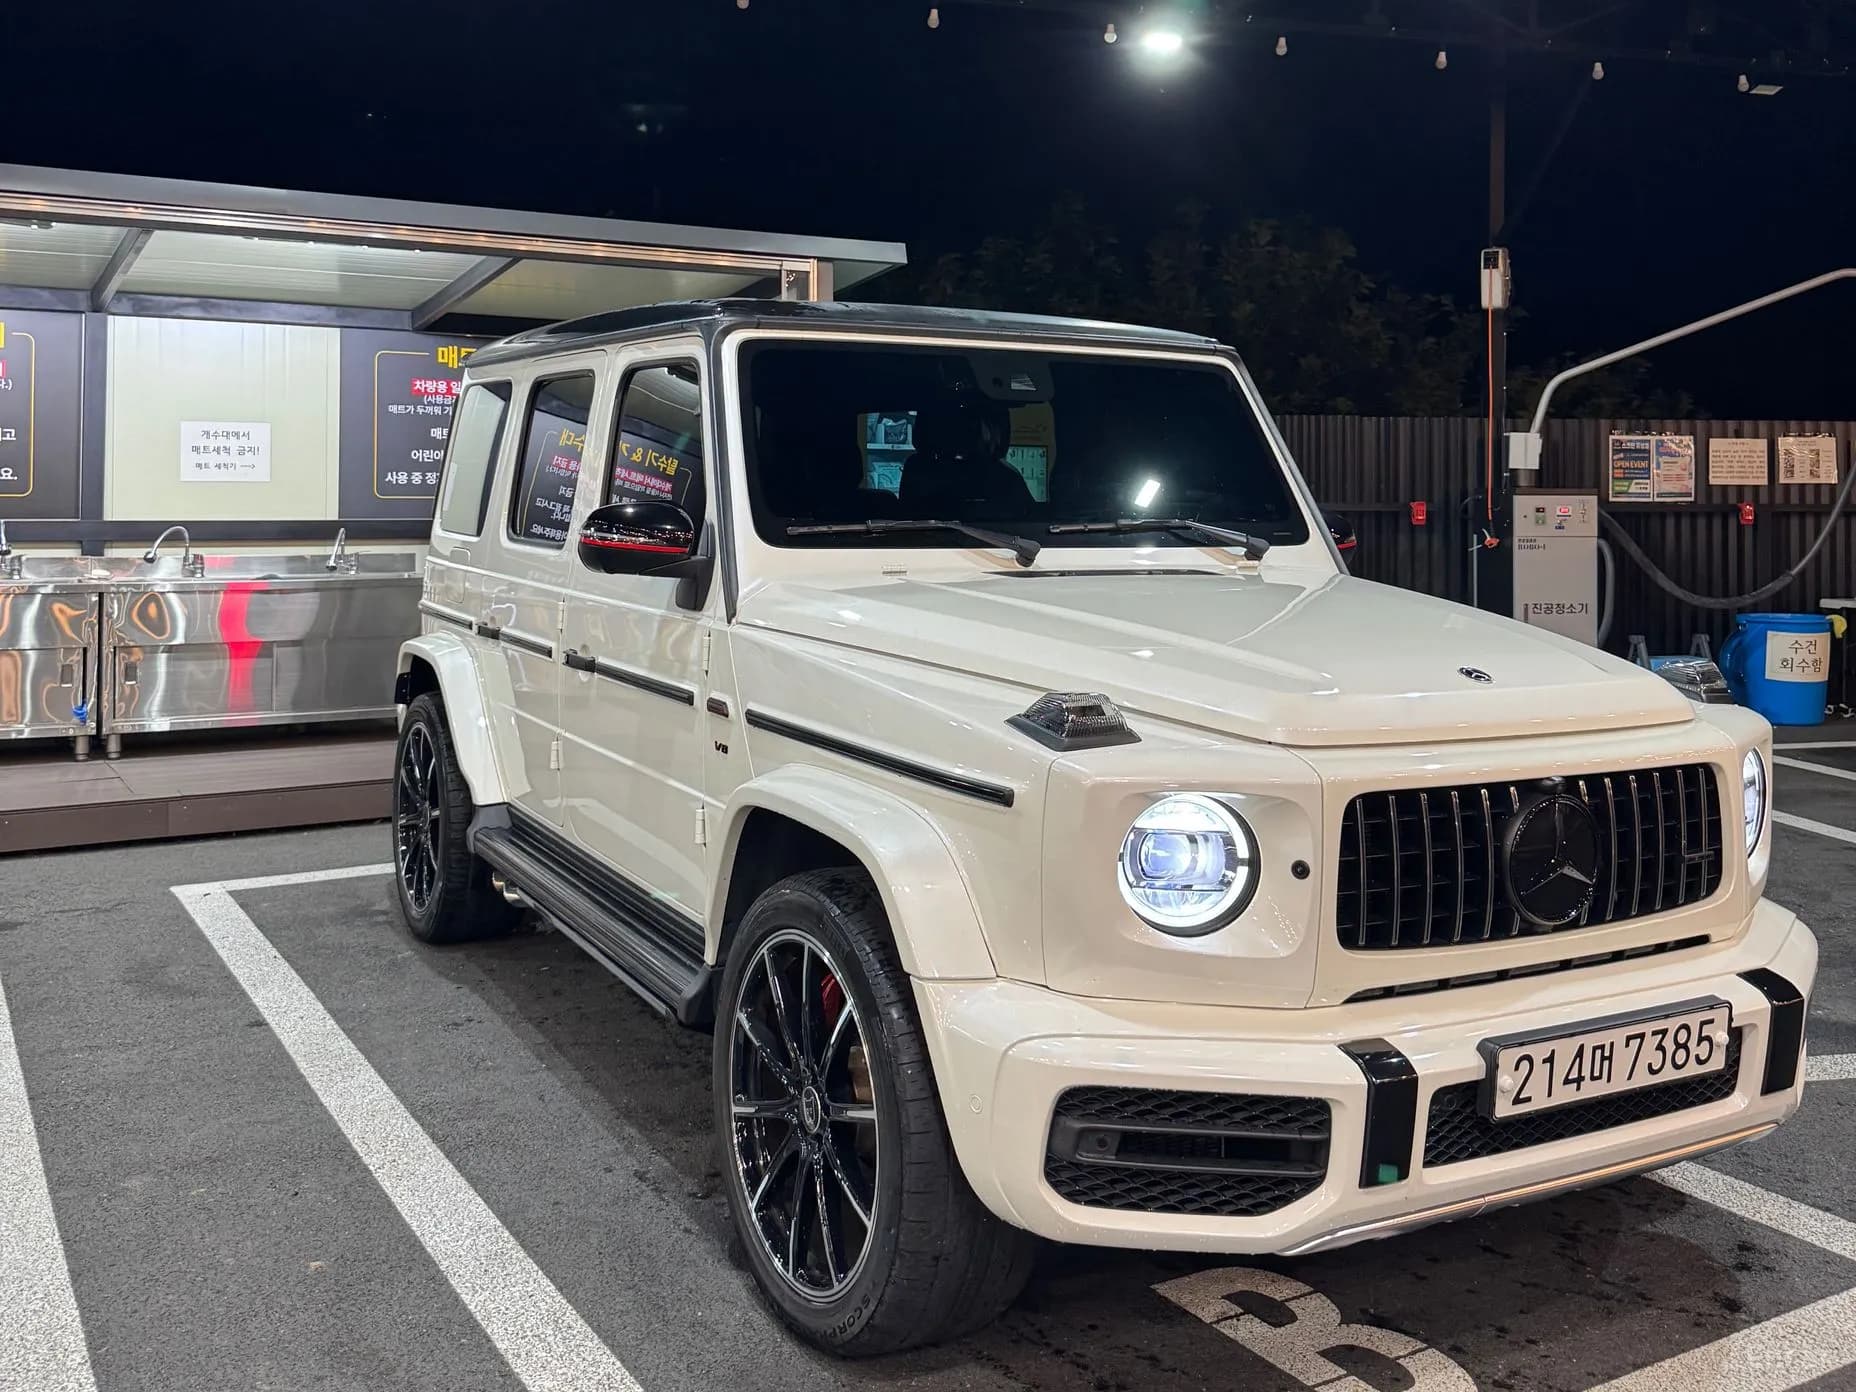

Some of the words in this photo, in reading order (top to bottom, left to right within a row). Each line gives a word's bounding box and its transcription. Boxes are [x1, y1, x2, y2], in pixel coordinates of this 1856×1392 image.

[413, 380, 448, 394] 차량용
[388, 404, 414, 415] 매트가
[201, 429, 250, 441] 개수대에서
[191, 445, 231, 456] 매트세척
[236, 445, 260, 456] 금지!
[1630, 460, 1649, 469] EVENT
[385, 471, 409, 485] 사용
[410, 472, 423, 485] 중
[425, 472, 440, 486] 정
[1788, 639, 1817, 655] 수건
[1779, 657, 1823, 674] 회수함
[714, 740, 728, 755] V8
[1624, 1018, 1716, 1082] 7385
